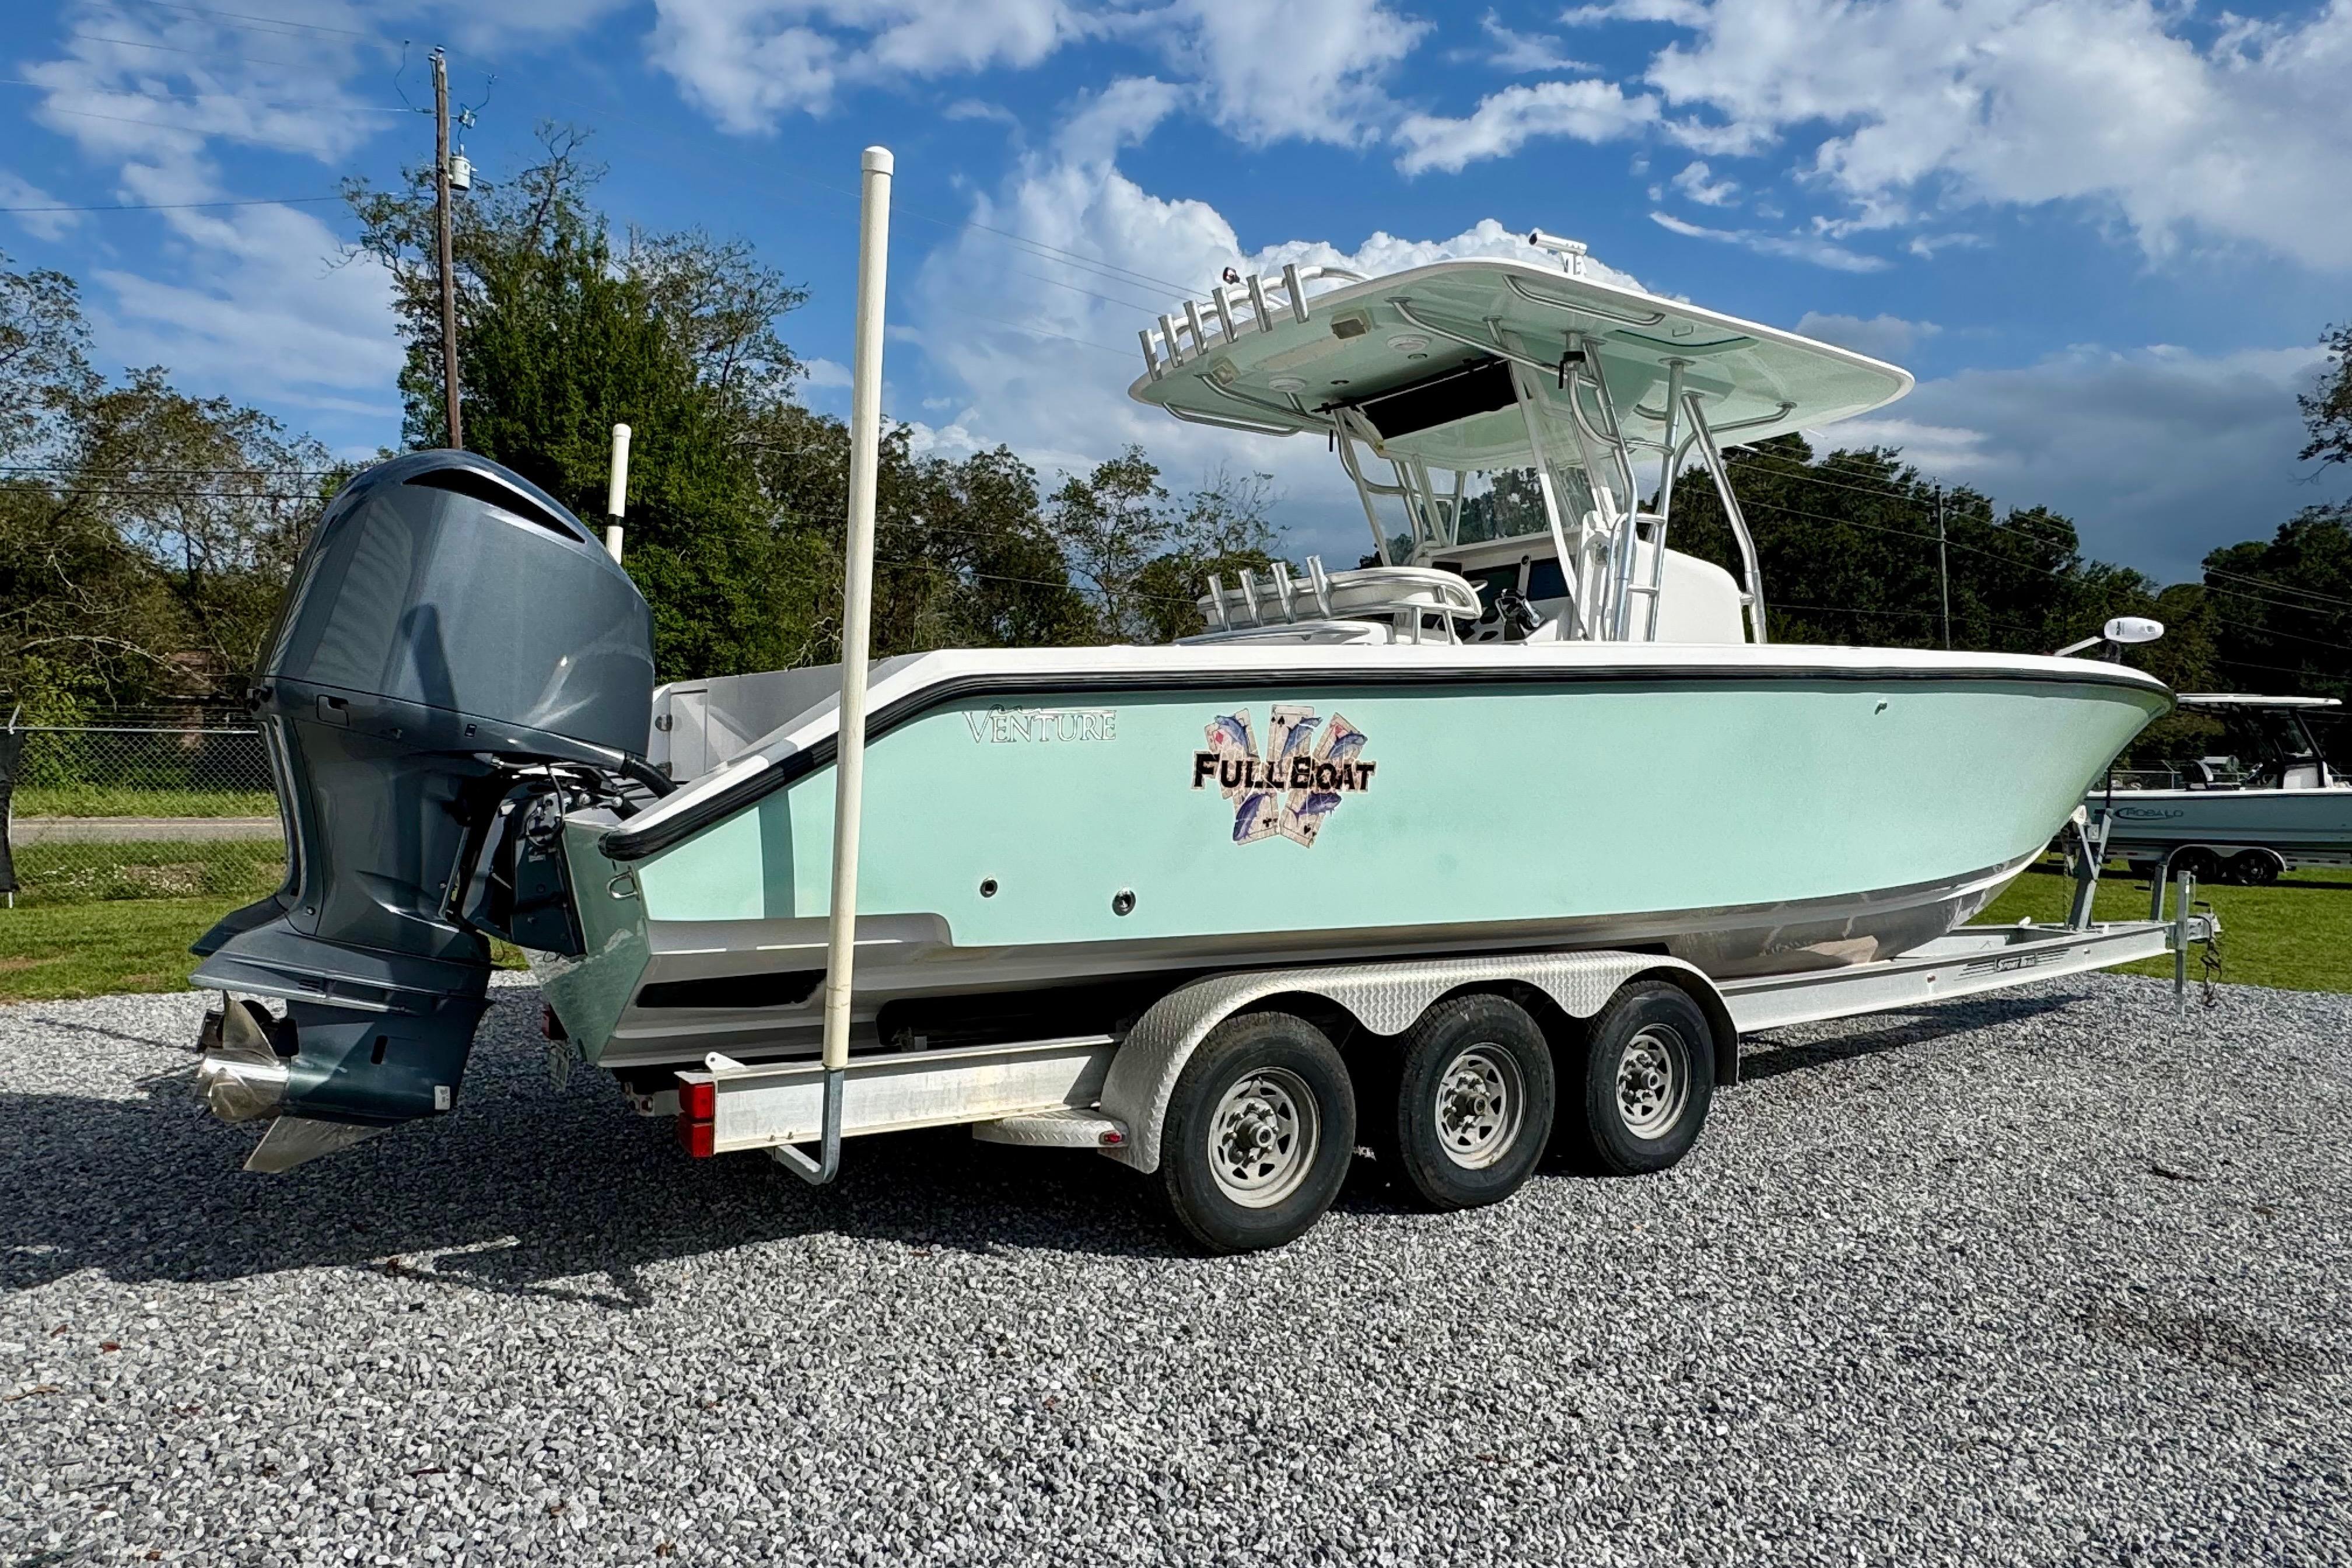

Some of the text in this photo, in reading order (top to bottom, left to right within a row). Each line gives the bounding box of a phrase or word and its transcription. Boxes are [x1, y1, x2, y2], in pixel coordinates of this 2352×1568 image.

[963, 709, 1116, 743] VENTURE
[1194, 753, 1375, 790] FULL BOAT
